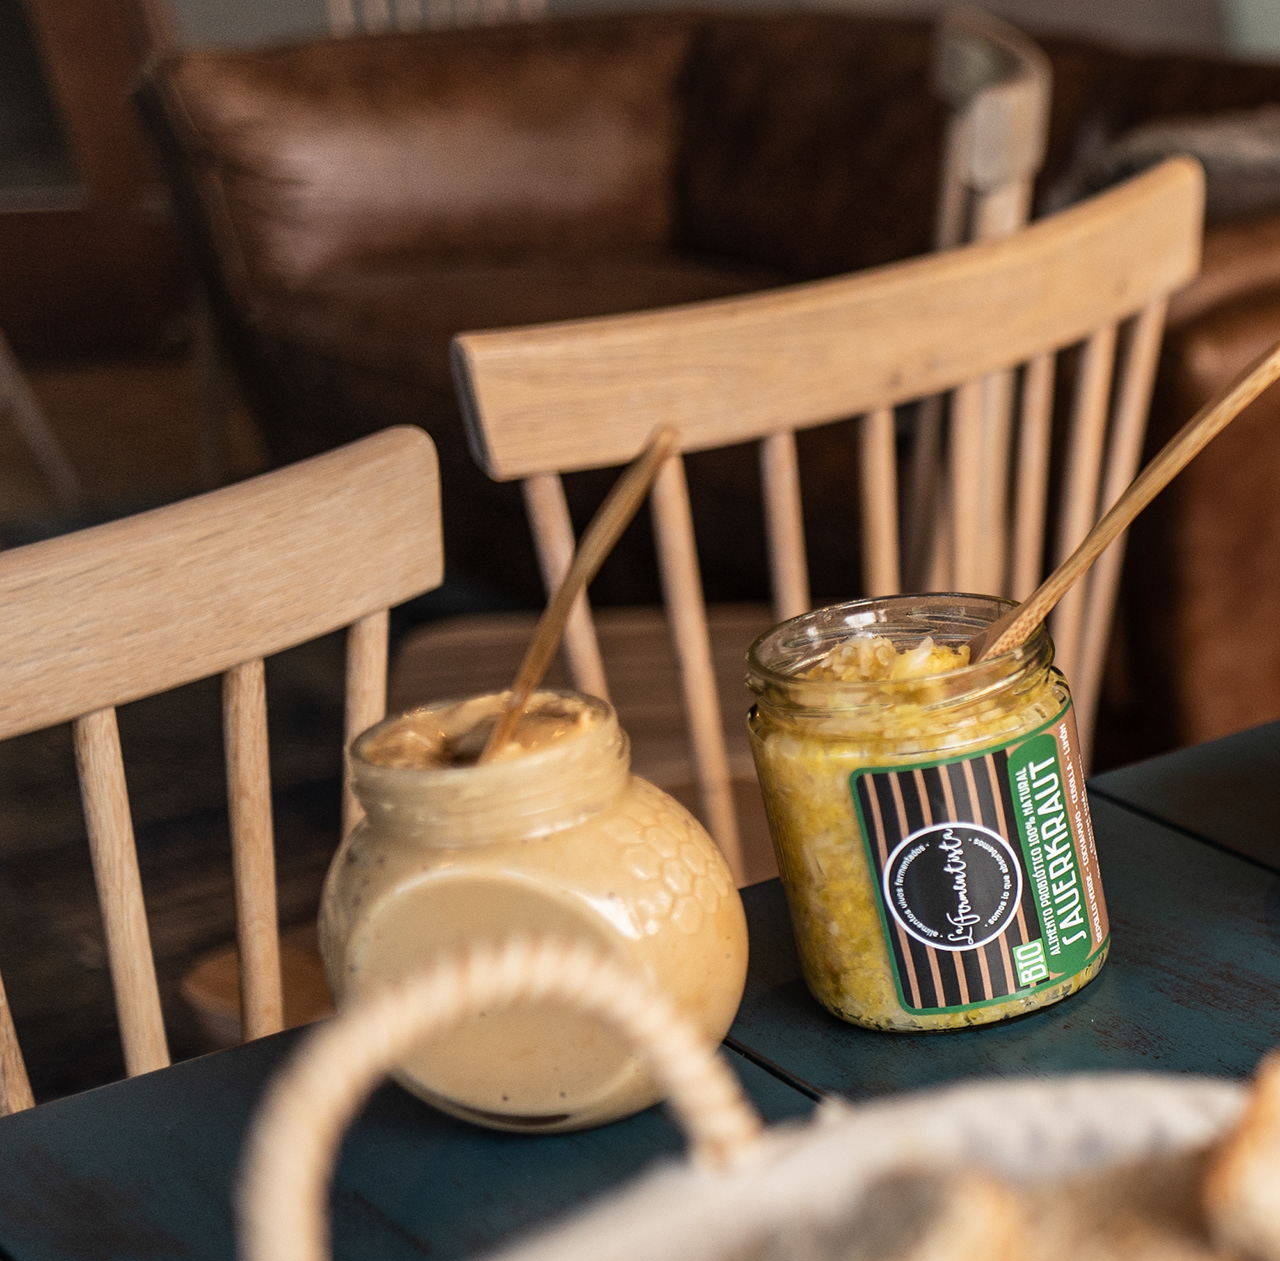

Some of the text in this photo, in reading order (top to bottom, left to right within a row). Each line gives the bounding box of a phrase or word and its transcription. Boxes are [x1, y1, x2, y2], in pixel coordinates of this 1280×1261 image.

[973, 838, 1009, 874] absorbemos
[1015, 767, 1061, 956] ALIMENTO PROBIÓTICO 100% NATURAL
[1028, 756, 1087, 946] SAUERKRAUT
[894, 844, 939, 938] alimentos vivos fermentados
[938, 828, 981, 945] La Fermentista
[1003, 875, 1012, 890] que
[987, 900, 1007, 925] somos
[1091, 902, 1103, 943] REPOLLO
[1016, 942, 1047, 983] BIO
